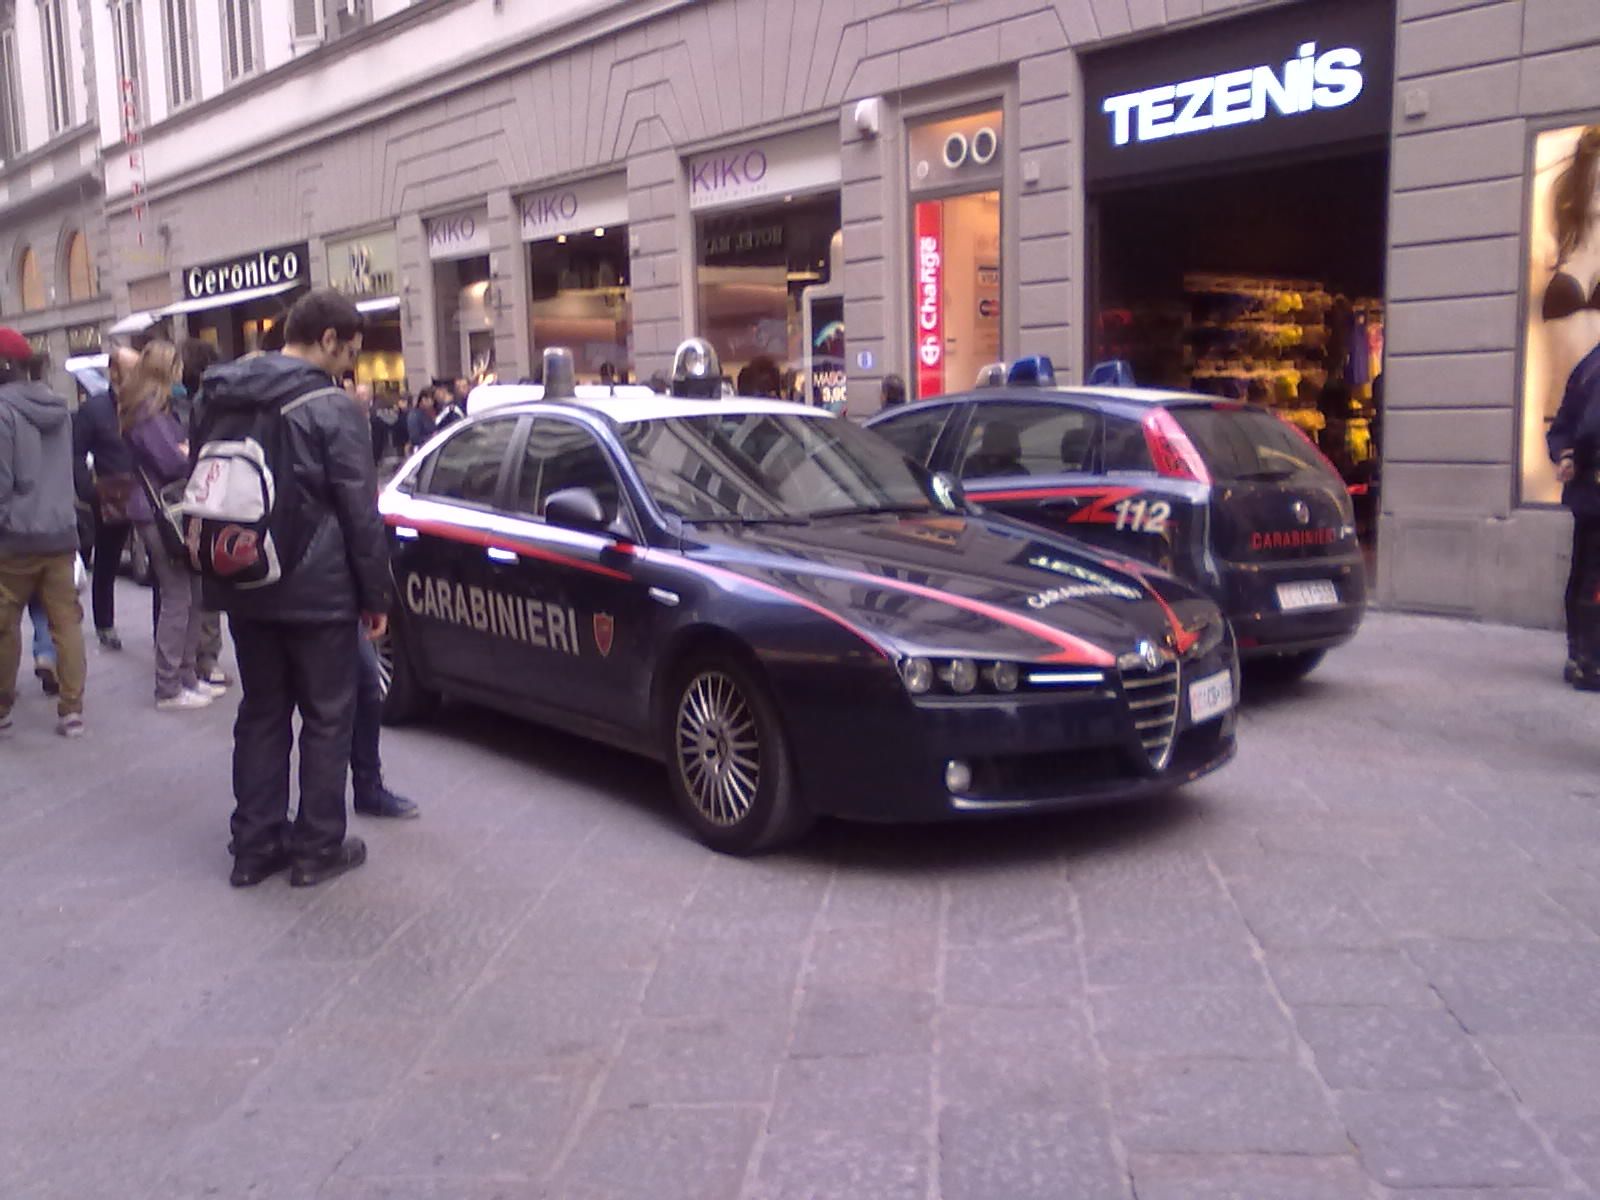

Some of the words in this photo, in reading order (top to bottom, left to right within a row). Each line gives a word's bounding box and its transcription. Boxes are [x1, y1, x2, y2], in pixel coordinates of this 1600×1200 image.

[691, 149, 767, 194] KIKO
[522, 191, 578, 228] KIKO
[429, 216, 476, 247] KIKO
[920, 235, 941, 330] Change
[1115, 499, 1171, 531] 112
[406, 571, 581, 656] CARABINIERI
